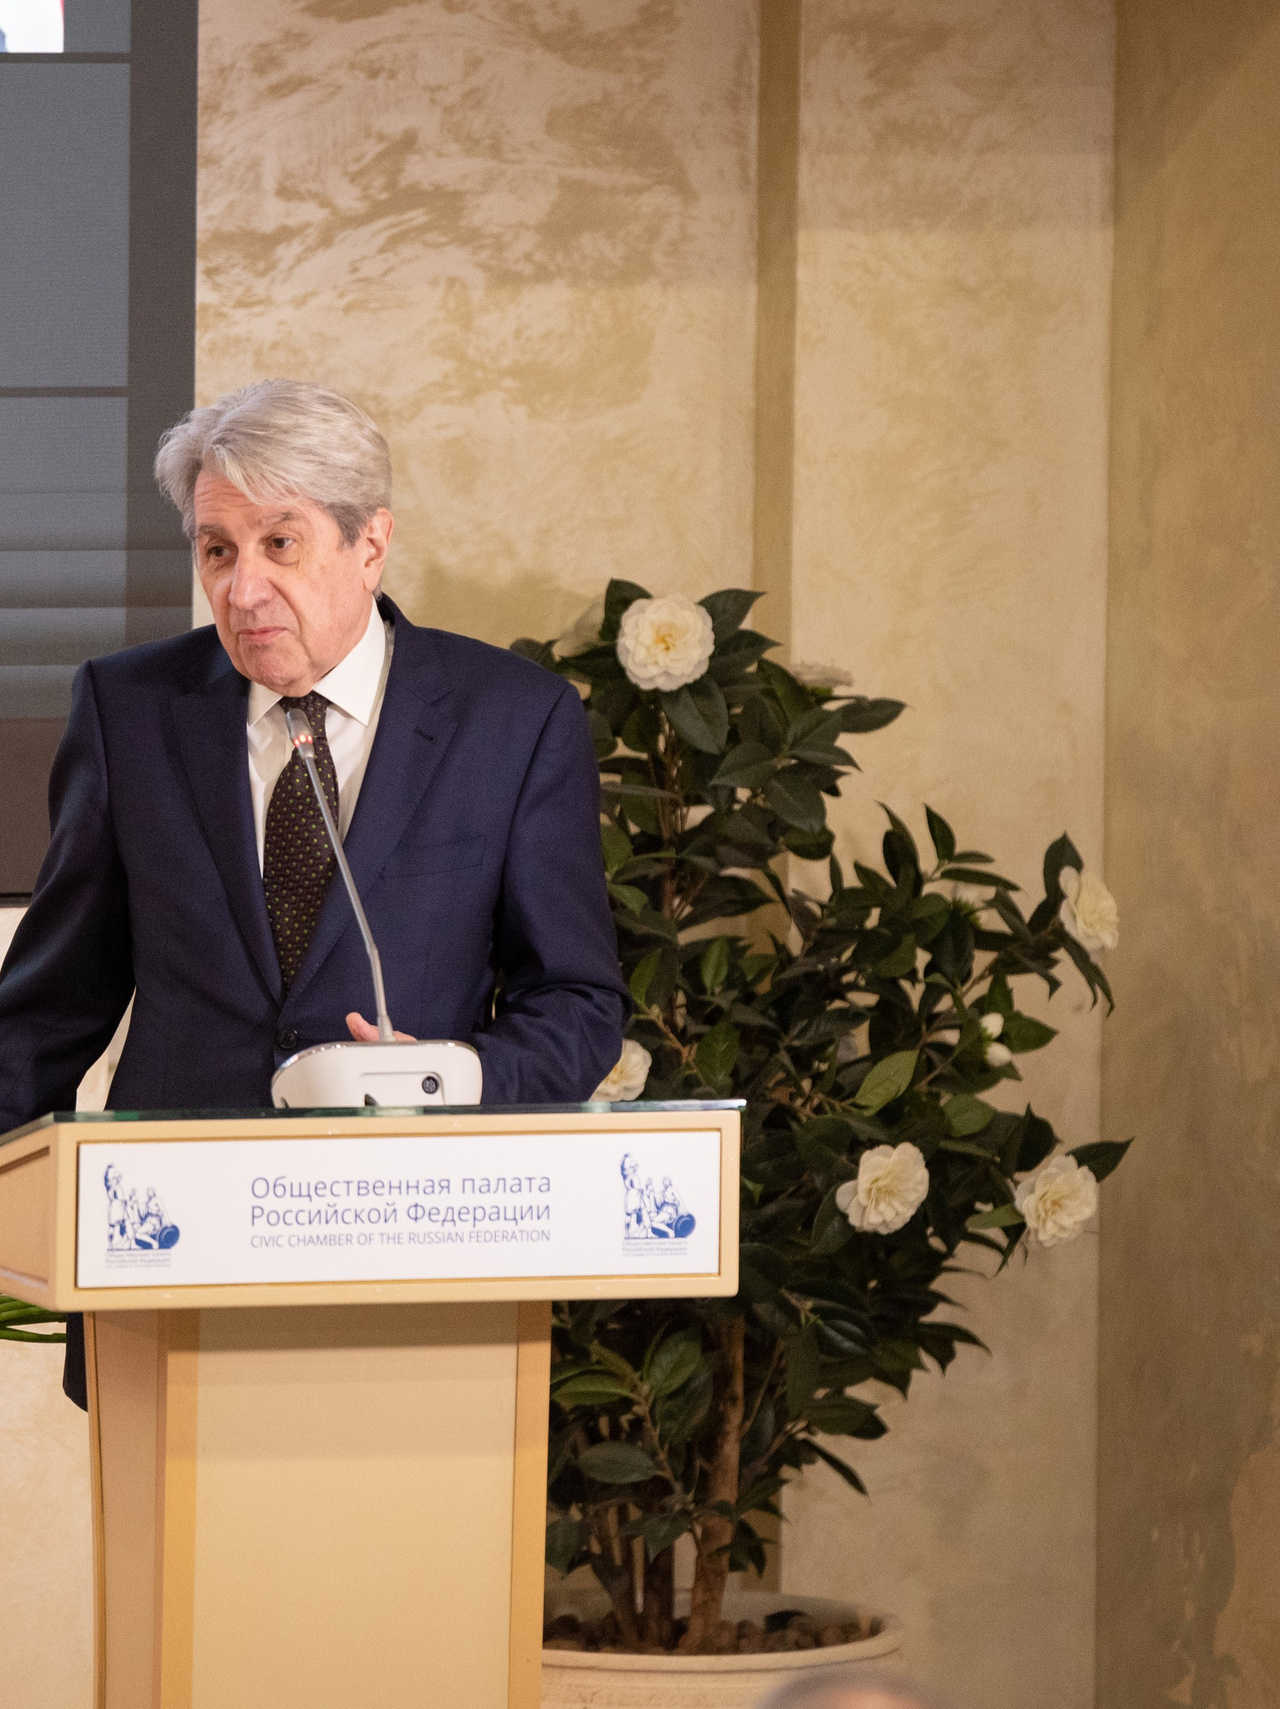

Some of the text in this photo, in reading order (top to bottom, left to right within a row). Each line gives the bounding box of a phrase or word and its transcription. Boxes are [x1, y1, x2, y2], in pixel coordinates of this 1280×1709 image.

[251, 1176, 551, 1202] Общественная палата
[251, 1202, 551, 1228] Российской Федерации
[251, 1230, 551, 1248] CIVIC CHAMBER OF THE RUSSIAN FEDERATION
